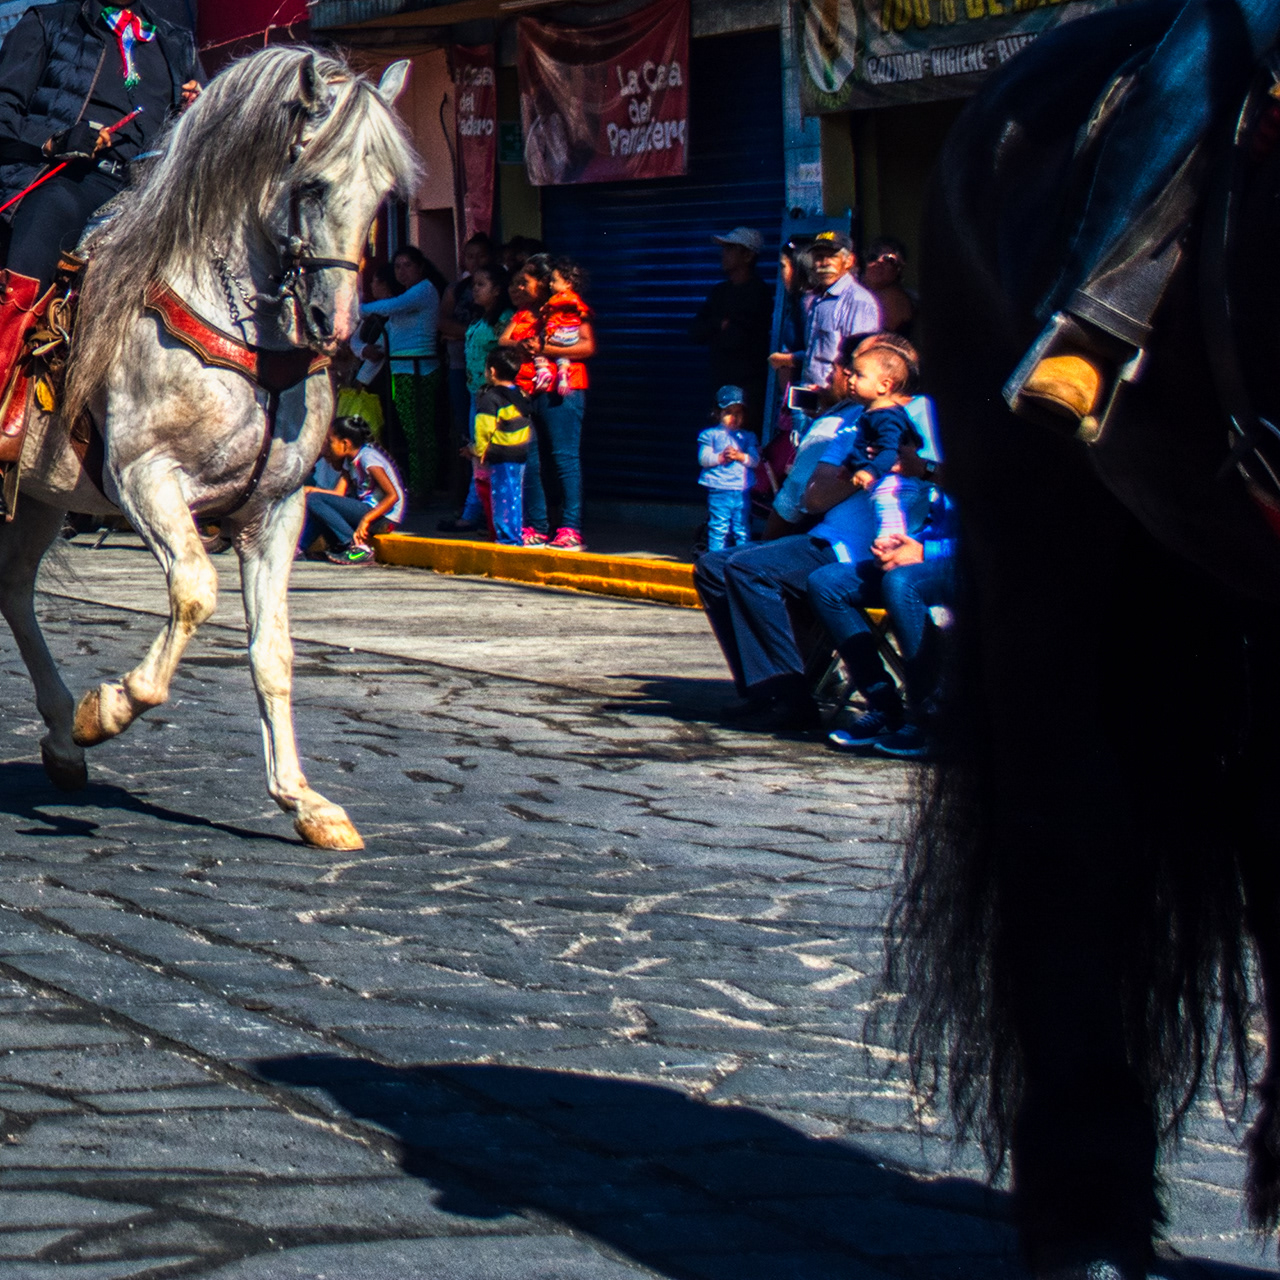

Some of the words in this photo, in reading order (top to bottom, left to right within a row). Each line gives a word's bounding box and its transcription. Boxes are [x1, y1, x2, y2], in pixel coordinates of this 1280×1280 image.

[931, 41, 989, 78] HIGIENE
[616, 65, 640, 96] La
[628, 95, 652, 124] del
